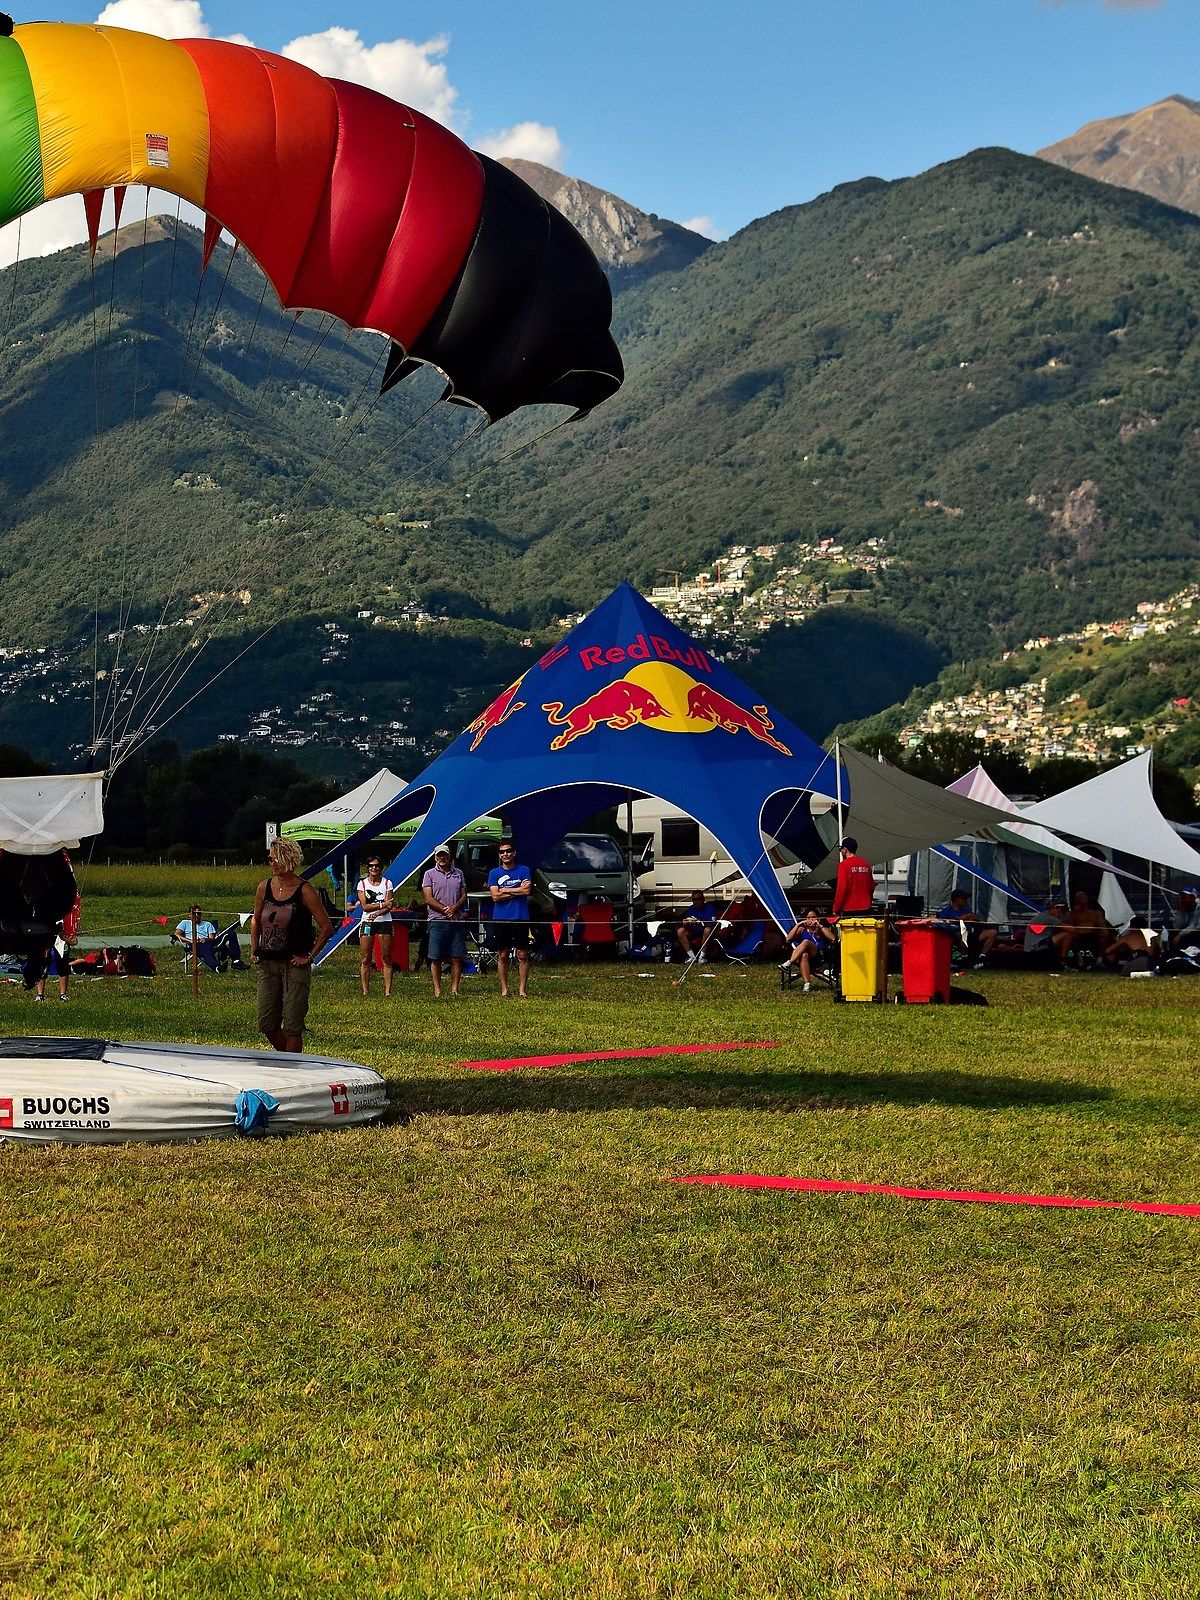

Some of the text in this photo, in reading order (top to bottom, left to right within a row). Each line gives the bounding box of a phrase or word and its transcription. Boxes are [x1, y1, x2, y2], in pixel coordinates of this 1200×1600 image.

[580, 634, 651, 671] Red
[650, 636, 712, 673] Bull
[23, 1097, 110, 1114] BUOCHS
[23, 1119, 110, 1129] SWITZERLAND
